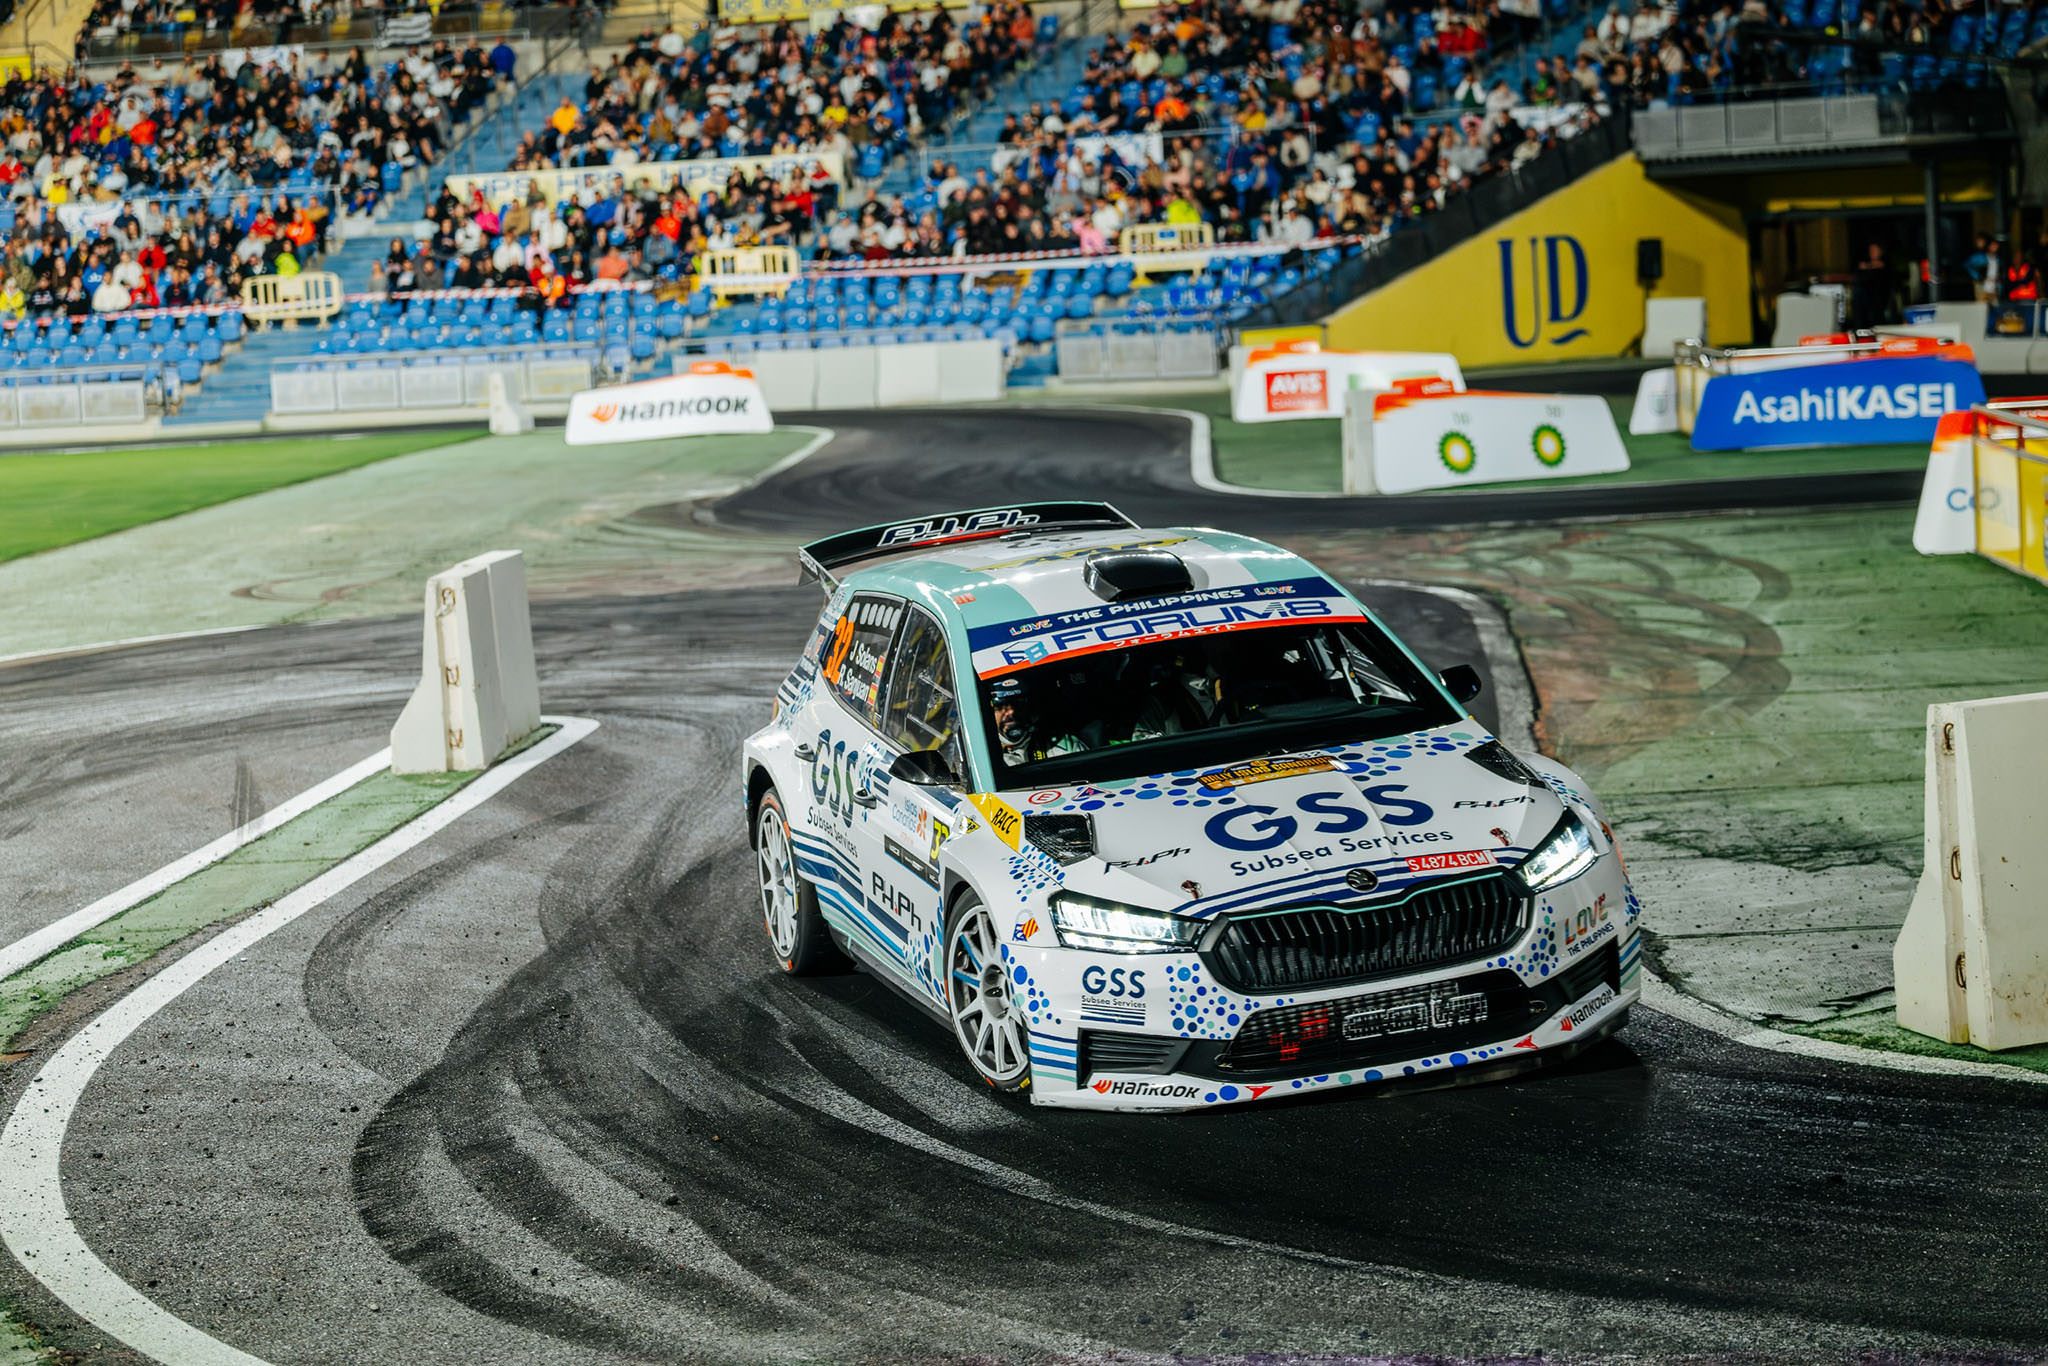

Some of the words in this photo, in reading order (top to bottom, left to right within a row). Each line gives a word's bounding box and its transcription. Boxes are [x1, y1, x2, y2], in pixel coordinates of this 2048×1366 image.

[1498, 235, 1588, 347] UD
[1270, 374, 1320, 395] AVIS
[1052, 600, 1332, 651] FORUM8
[1057, 609, 1103, 624] THE
[1111, 588, 1246, 616] PHILIPPINES
[812, 728, 859, 829] GSS
[991, 807, 1018, 835] RACC
[1205, 784, 1434, 851] GSS
[1230, 846, 1333, 876] Subsea
[1339, 830, 1454, 852] Services
[1565, 893, 1608, 945] LOVE
[1567, 945, 1580, 957] THE
[1581, 921, 1615, 950] PHILIPPINES
[1081, 994, 1110, 1006] Subsea
[1112, 998, 1147, 1009] Services
[1082, 965, 1146, 998] GSS
